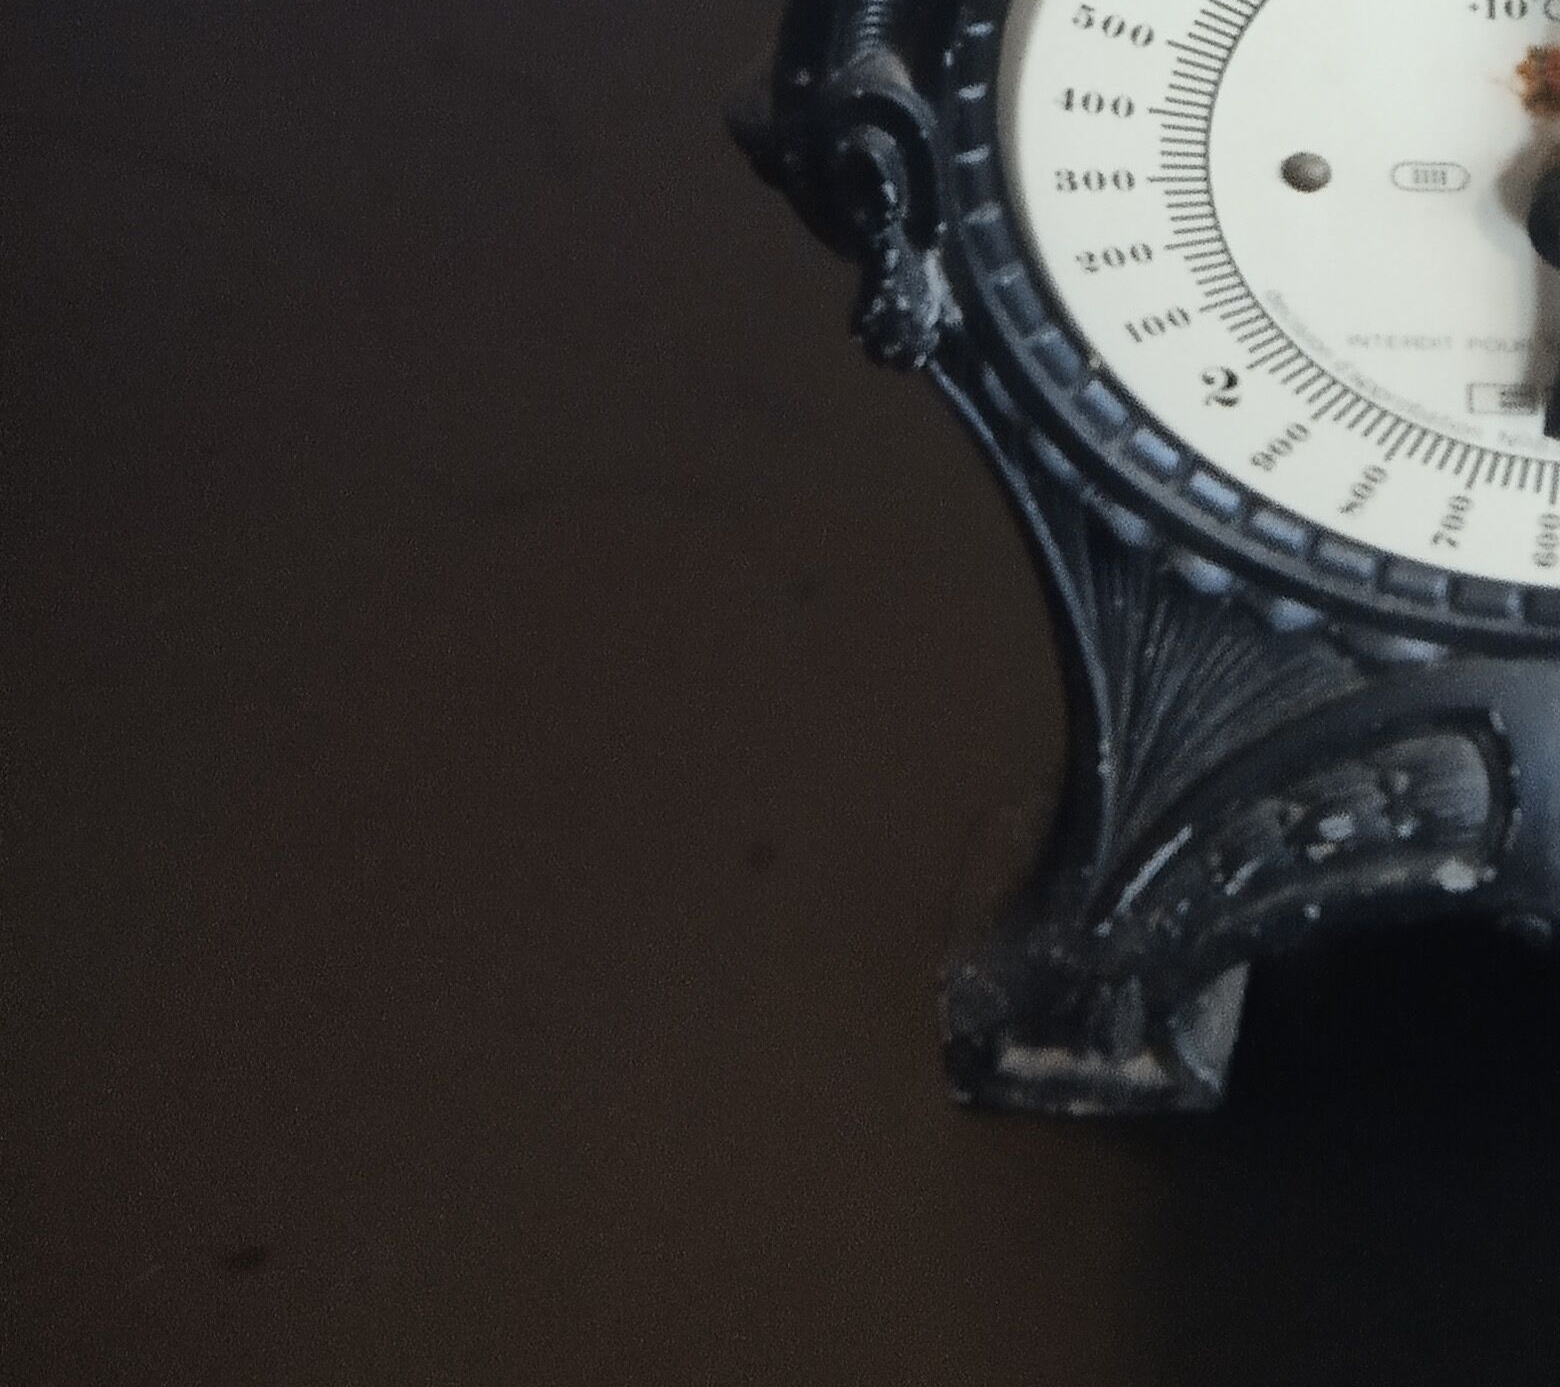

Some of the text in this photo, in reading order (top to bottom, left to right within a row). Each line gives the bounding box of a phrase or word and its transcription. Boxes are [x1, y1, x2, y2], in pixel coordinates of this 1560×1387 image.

[1070, 2, 1156, 49] 500
[1054, 86, 1137, 119] 400
[1053, 168, 1137, 194] 300
[1074, 241, 1155, 275] 200
[1123, 306, 1193, 345] 100
[1200, 365, 1242, 410] 2
[1249, 422, 1311, 473] 900
[1339, 464, 1388, 515] 800
[1430, 493, 1472, 550] 700
